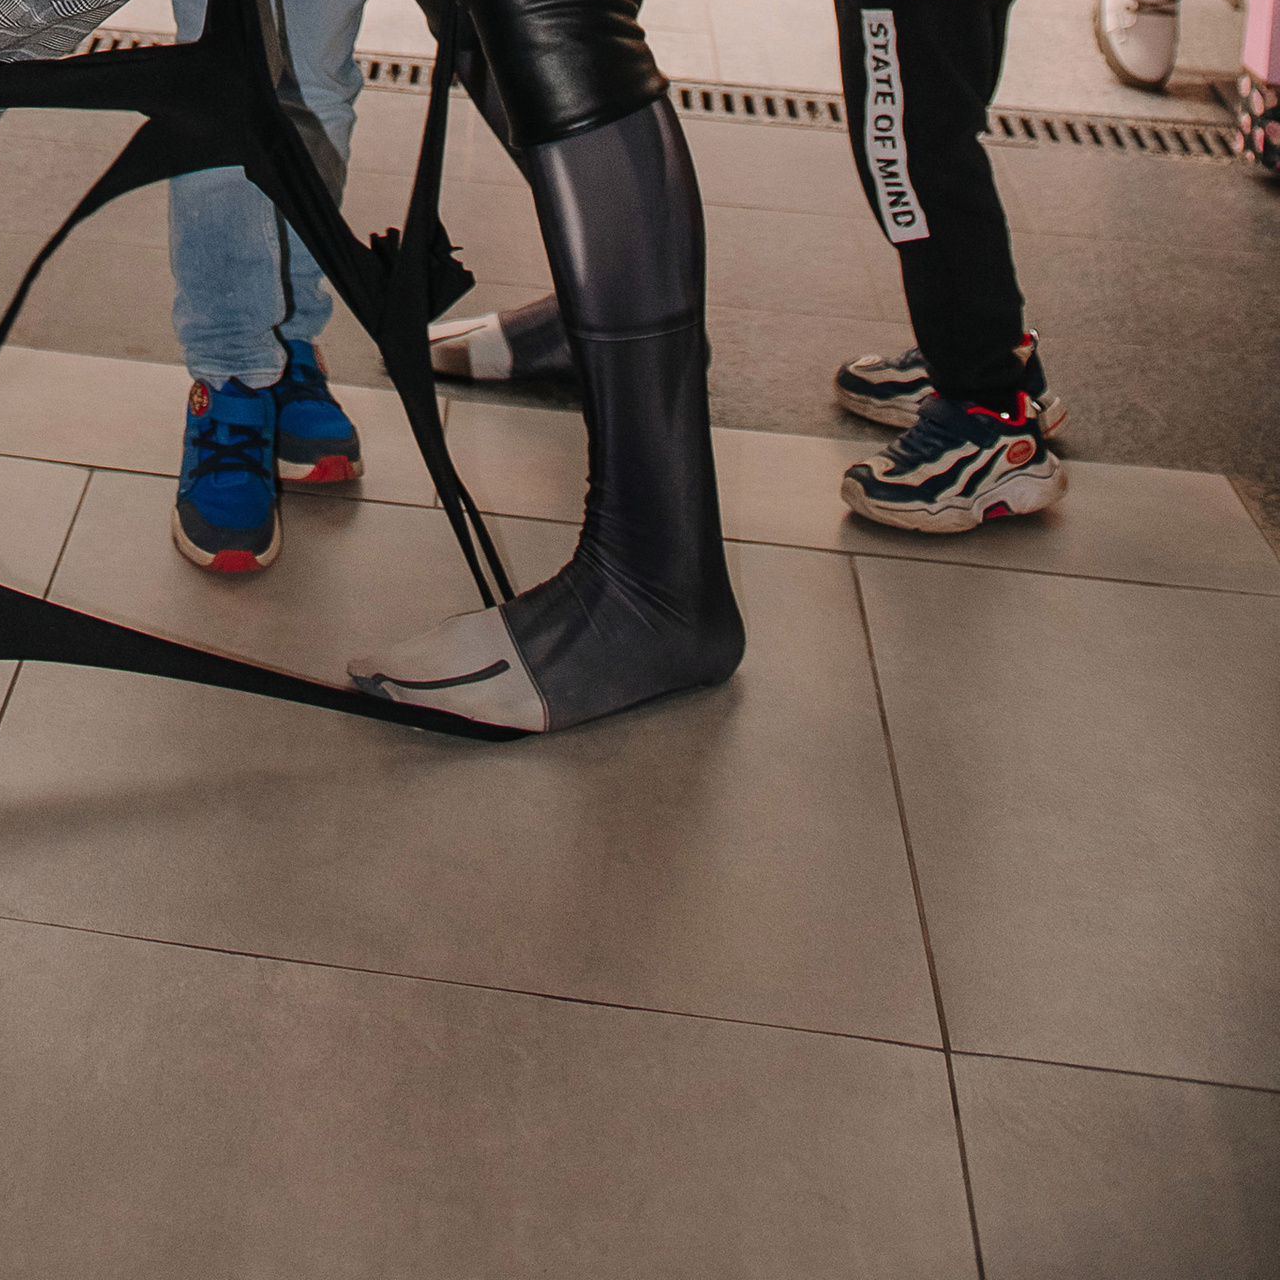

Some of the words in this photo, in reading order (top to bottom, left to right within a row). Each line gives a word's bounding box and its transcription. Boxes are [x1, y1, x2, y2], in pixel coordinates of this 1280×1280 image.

[870, 22, 896, 106] STATE
[873, 113, 897, 150] OF
[875, 157, 917, 229] MIND
